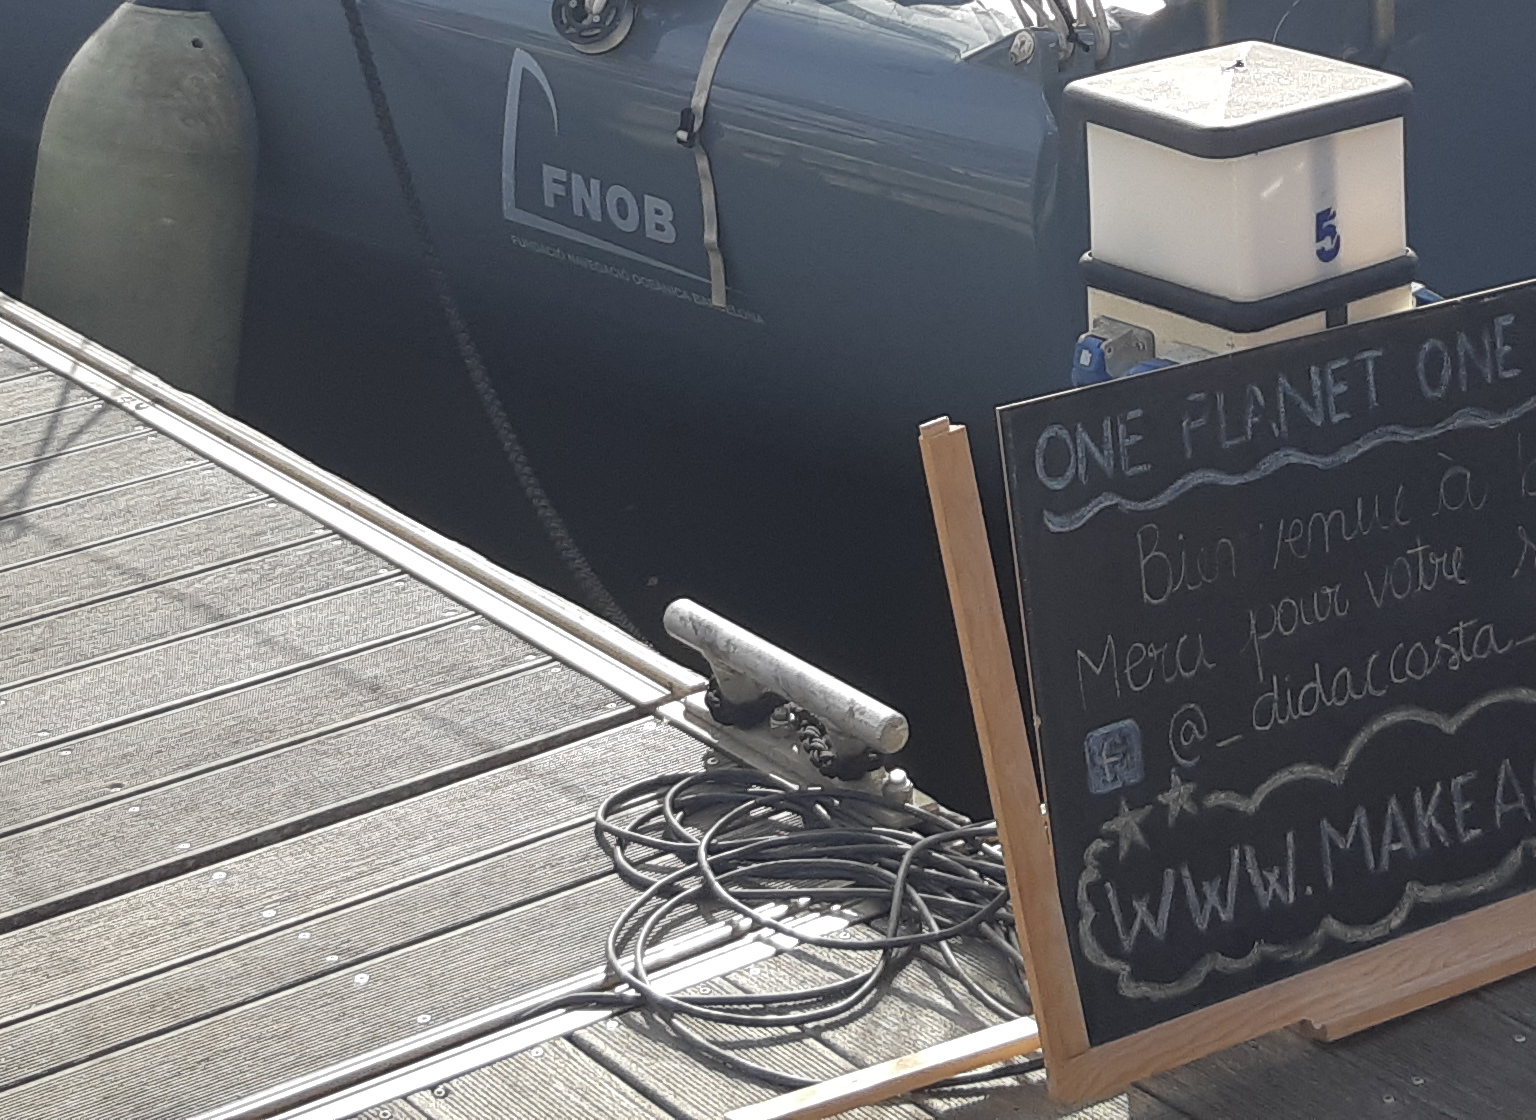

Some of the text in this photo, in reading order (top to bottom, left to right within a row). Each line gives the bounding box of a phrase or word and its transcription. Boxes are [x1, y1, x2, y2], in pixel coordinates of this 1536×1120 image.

[542, 164, 677, 244] FNOB
[1315, 207, 1341, 263] 5
[1035, 408, 1152, 490] ONE
[1417, 313, 1522, 399] ONE
[1431, 451, 1489, 517] à
[1241, 583, 1350, 683] pour
[1364, 535, 1470, 609] votre
